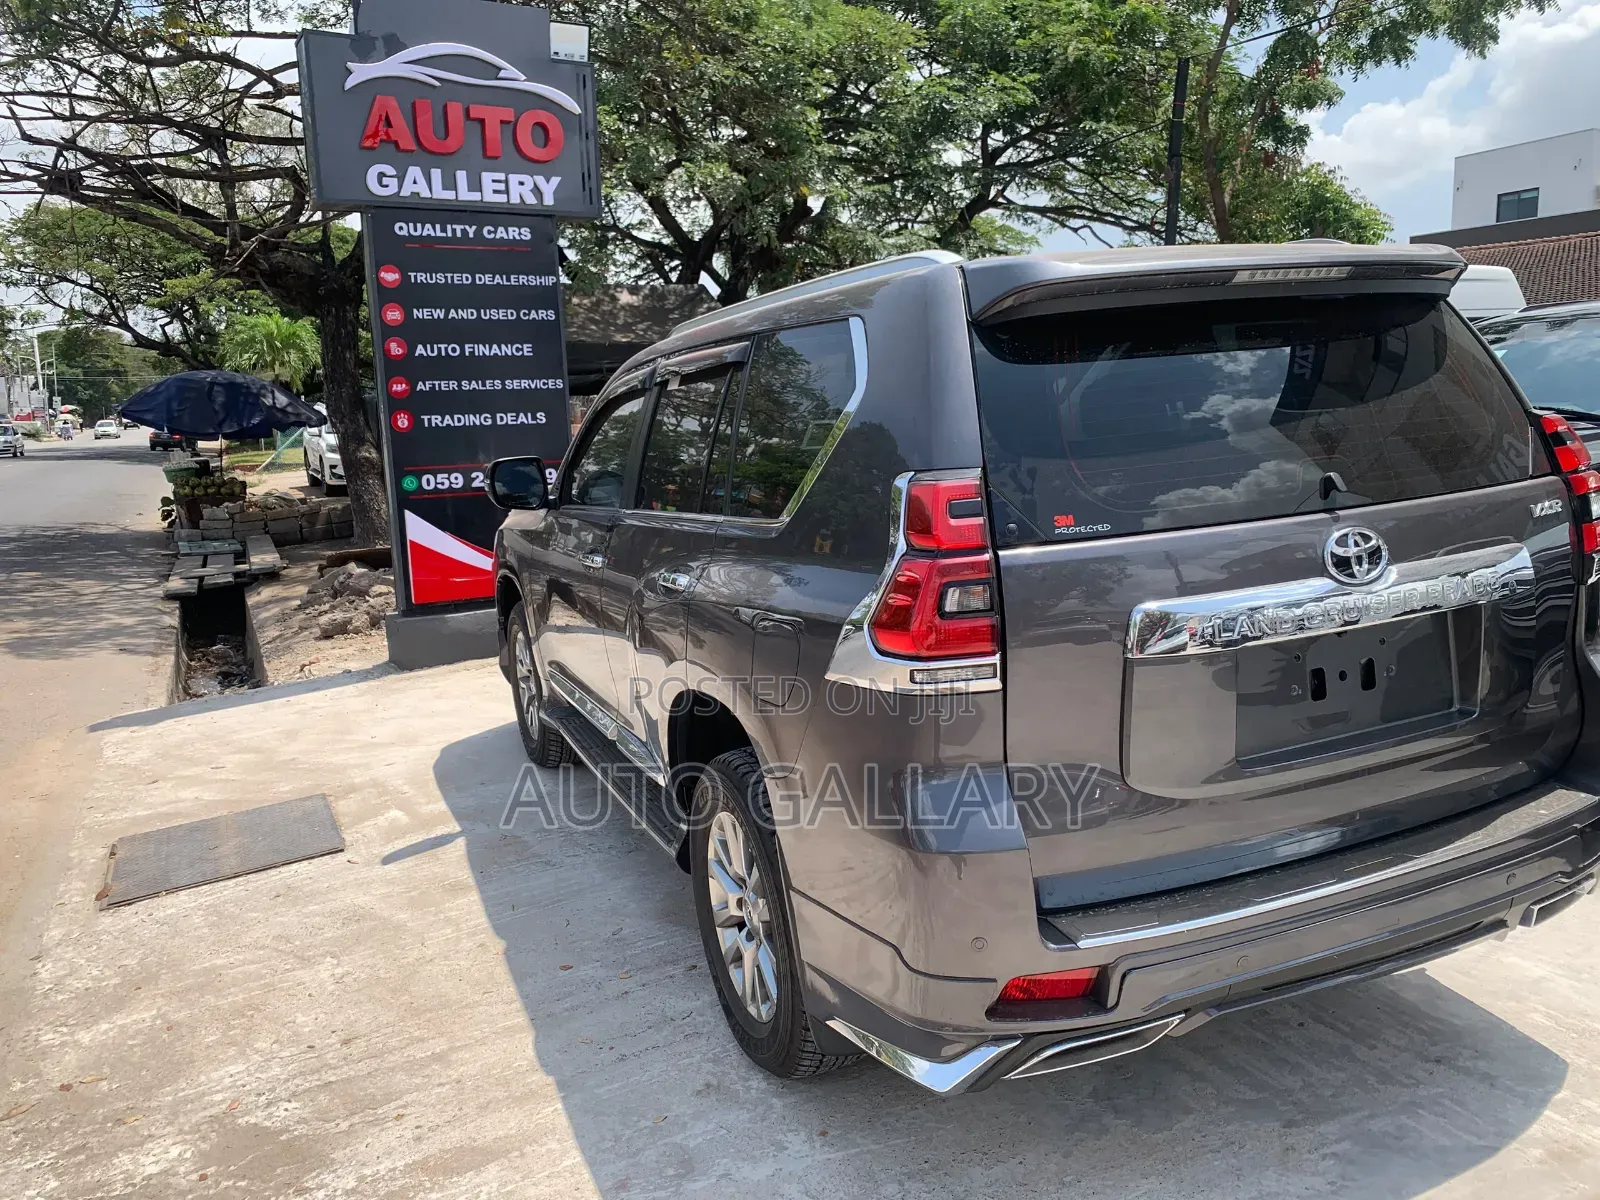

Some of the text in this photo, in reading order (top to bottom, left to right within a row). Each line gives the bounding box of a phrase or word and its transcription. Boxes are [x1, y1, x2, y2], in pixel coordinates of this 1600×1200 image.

[360, 94, 565, 163] AUTO
[365, 163, 562, 206] GALLERY
[394, 222, 532, 240] QUALITY CARS
[408, 272, 557, 287] TRUSTED DEALERSHIP
[413, 308, 556, 321] NEW AND USED CARS
[414, 343, 533, 357] AUTO FINANCE
[416, 378, 564, 391] AFTER SALES SERVICES
[421, 411, 547, 428] TRADING DEALS
[421, 472, 464, 491] 059
[1053, 514, 1075, 527] 3M
[1054, 523, 1111, 534] PROTECTED
[1211, 608, 1298, 641] LAND
[1302, 587, 1422, 630] CRUISER
